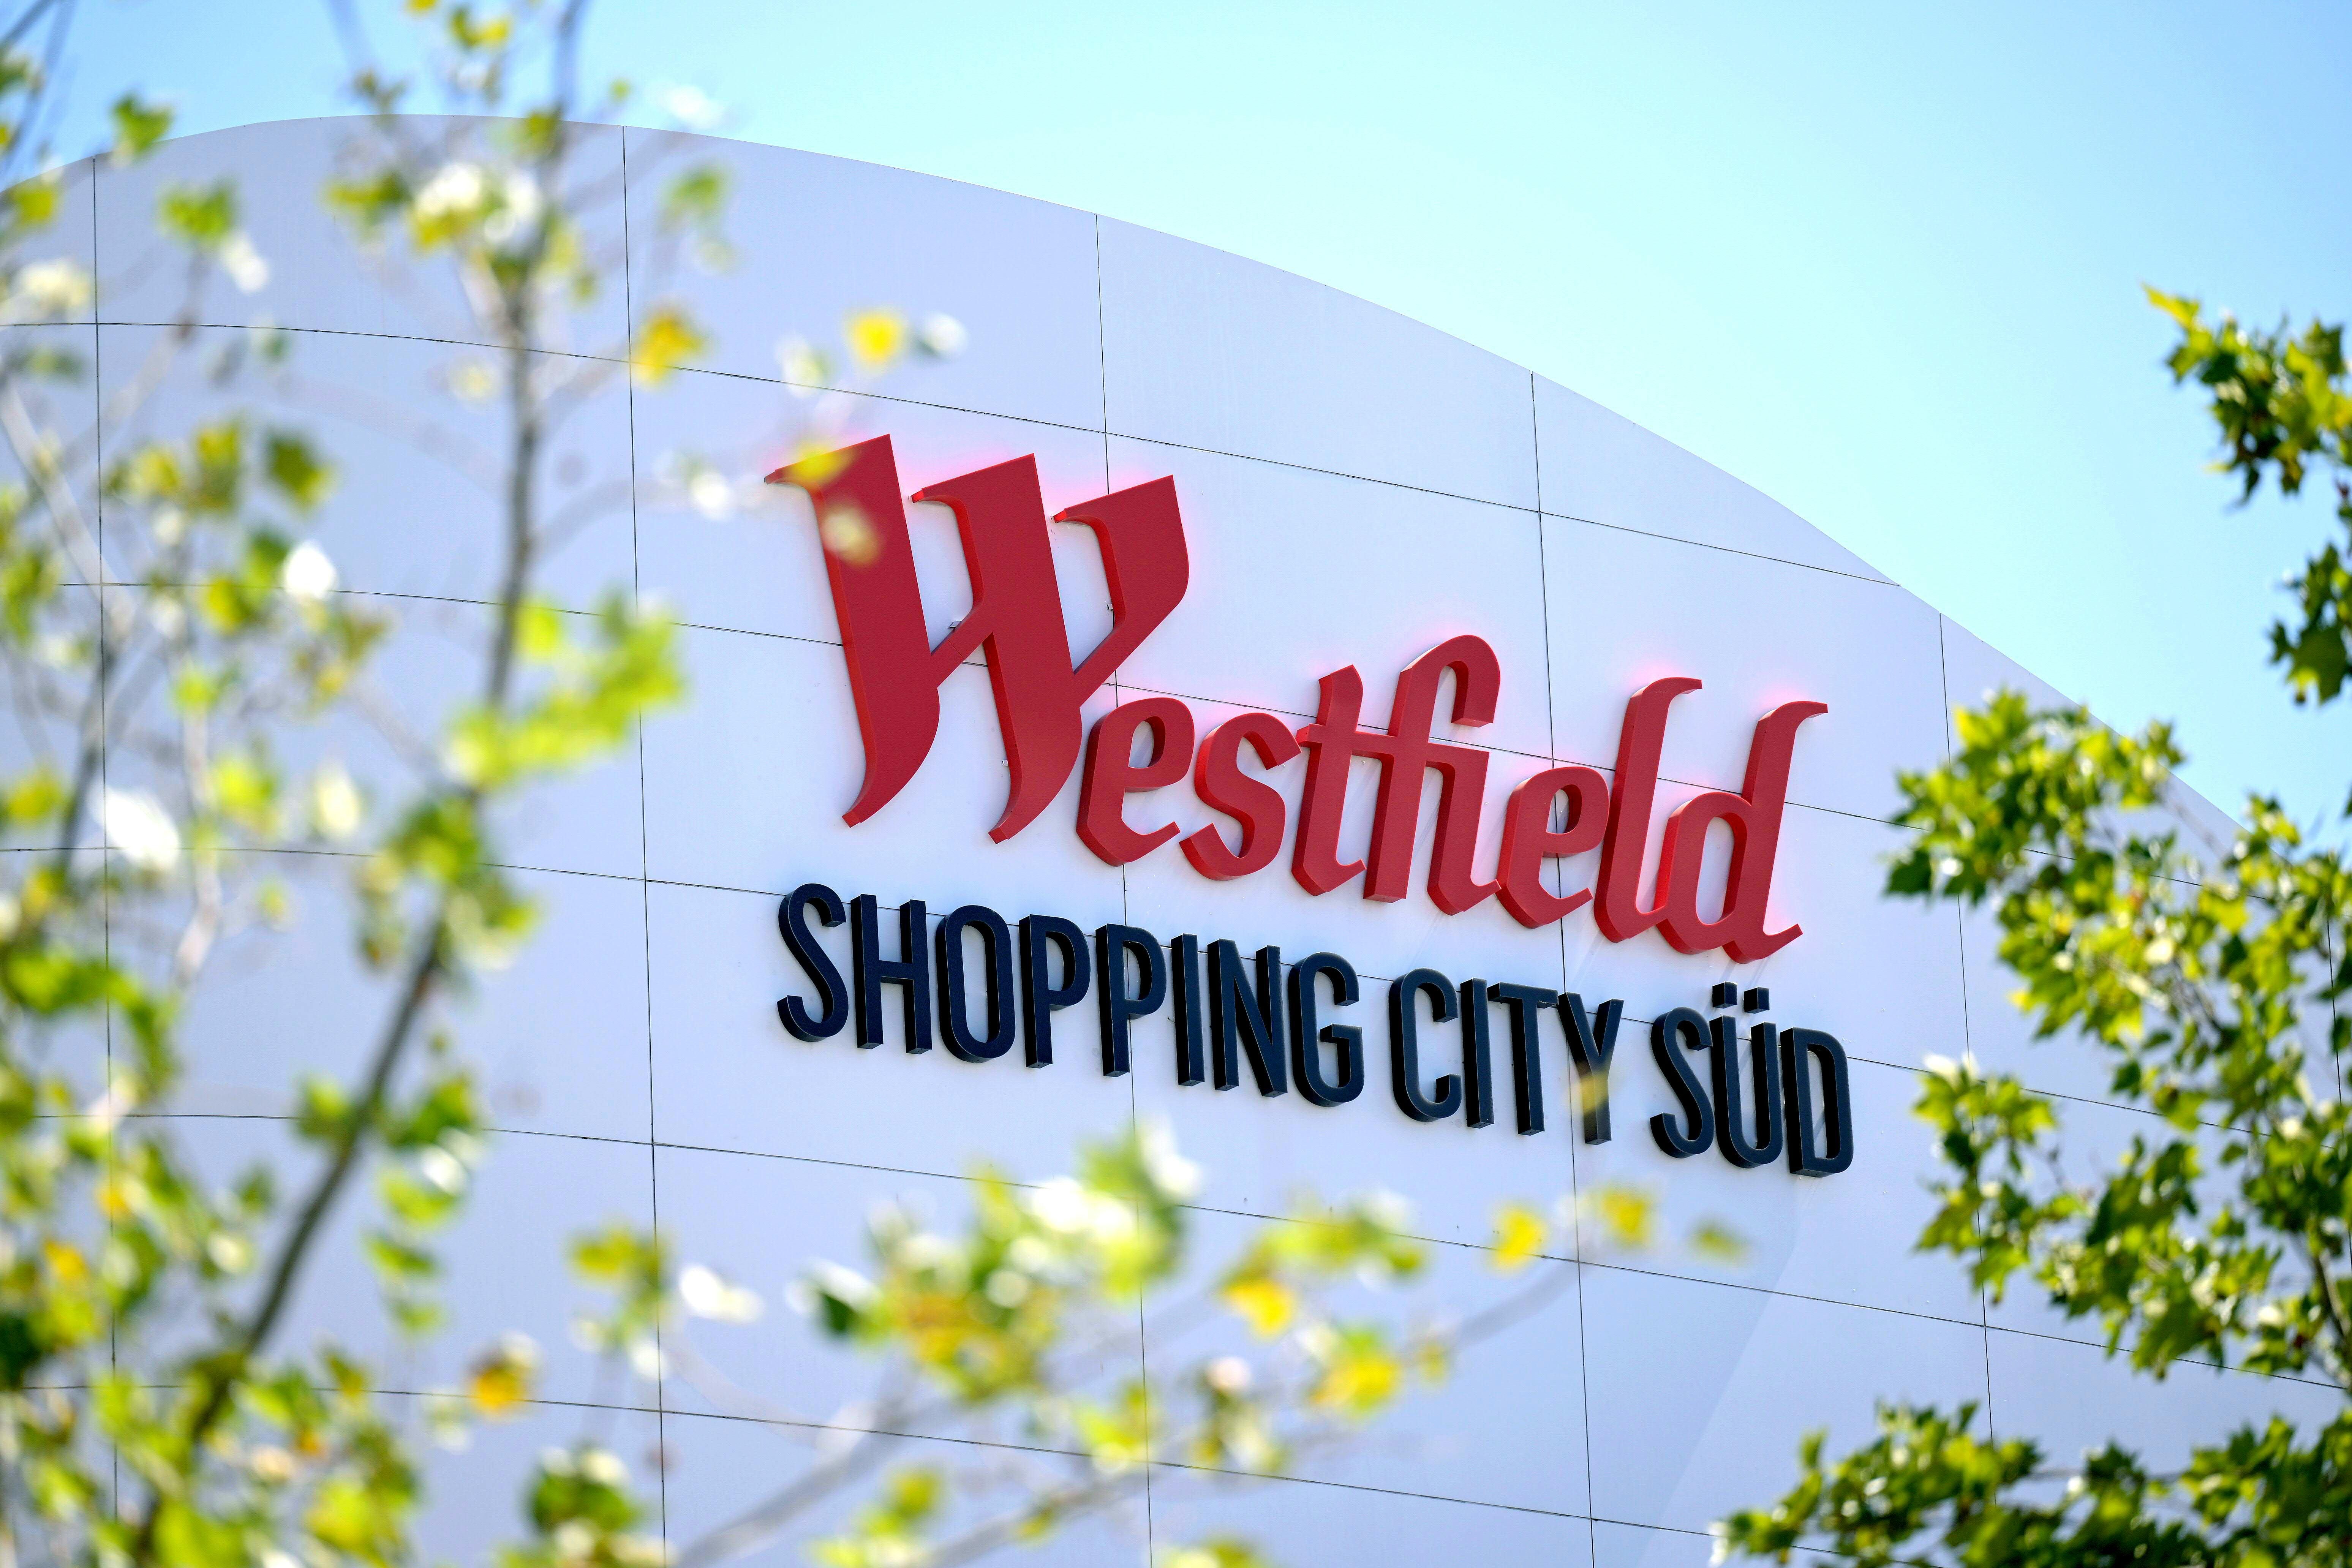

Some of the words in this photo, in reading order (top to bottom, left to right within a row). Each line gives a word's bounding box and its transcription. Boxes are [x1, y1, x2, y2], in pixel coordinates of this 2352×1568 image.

[765, 434, 1828, 963] Westfield
[777, 883, 1364, 1107] SHOPPING
[1389, 968, 1623, 1144] CITY
[1649, 982, 1854, 1178] SÜD
